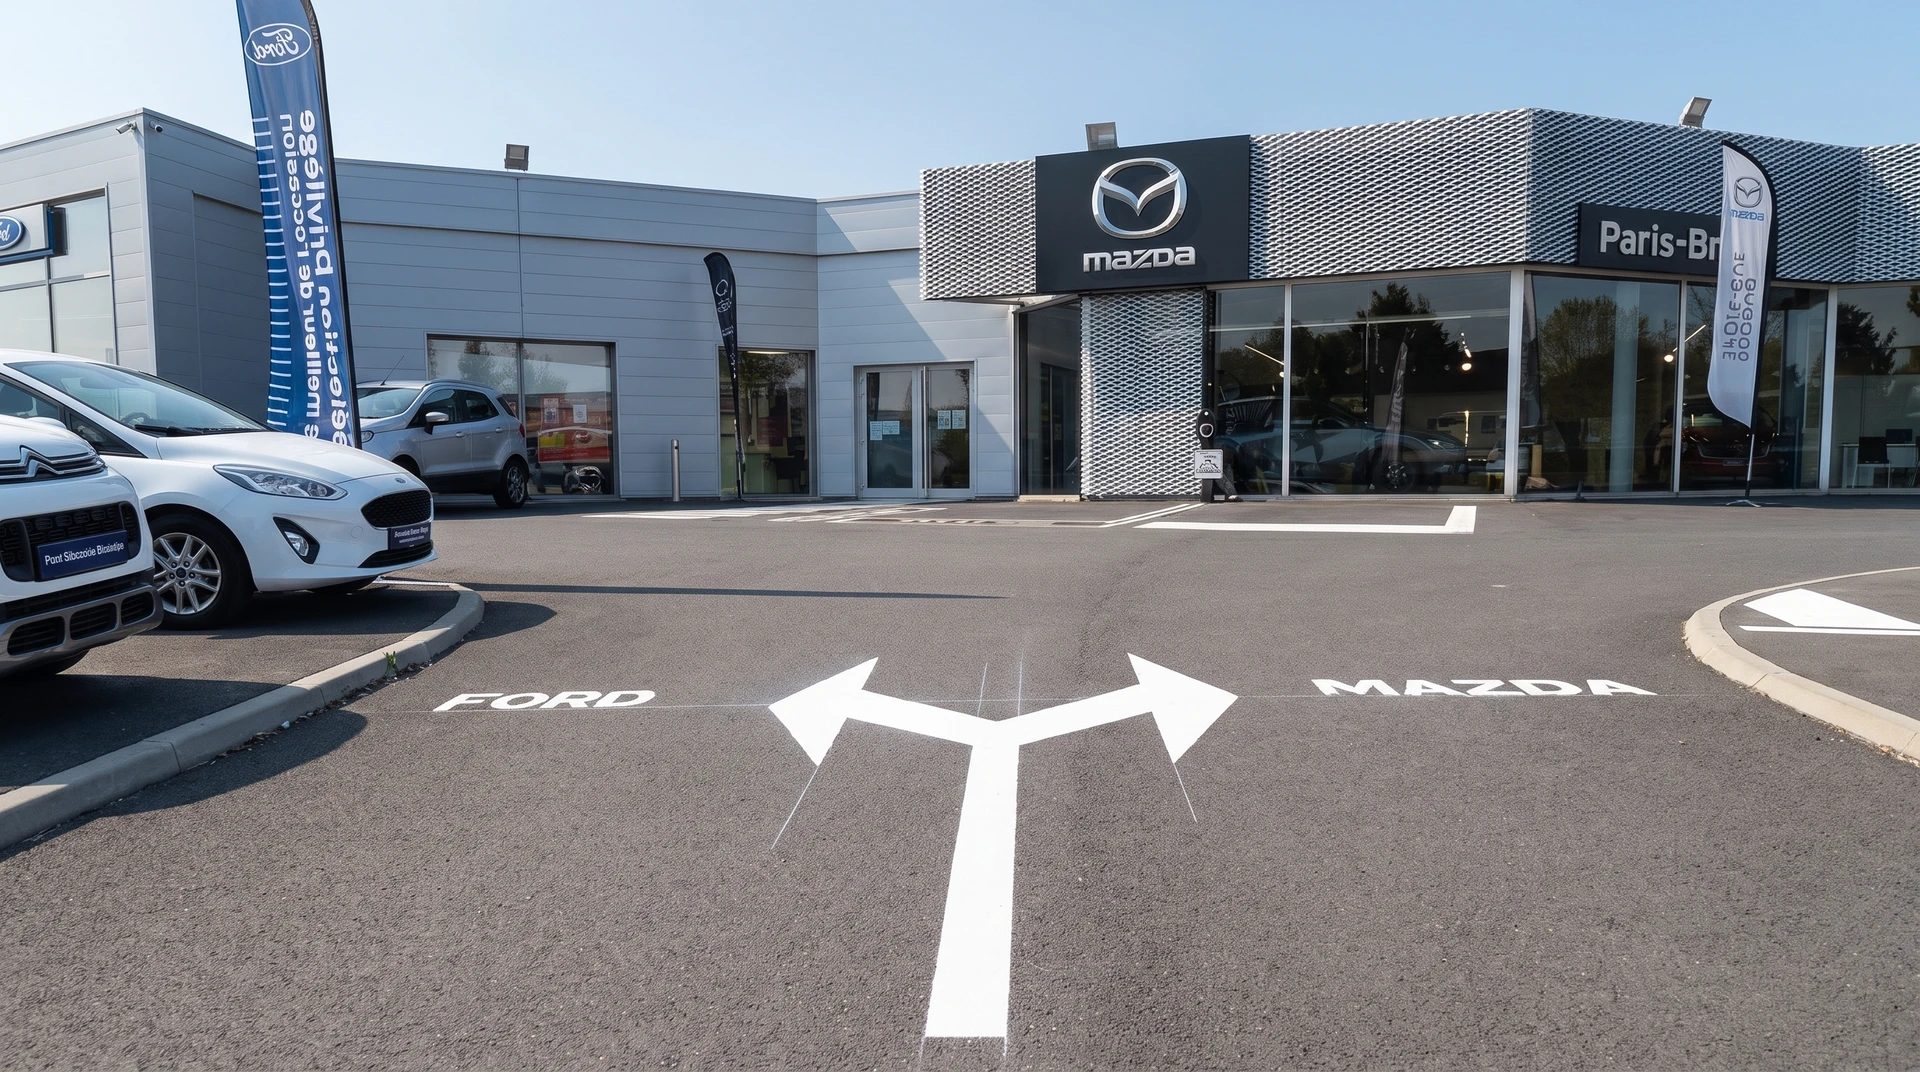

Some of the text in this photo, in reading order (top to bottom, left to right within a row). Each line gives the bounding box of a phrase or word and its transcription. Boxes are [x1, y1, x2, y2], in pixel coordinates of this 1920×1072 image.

[1083, 246, 1196, 272] mazda
[1311, 679, 1658, 697] MAZDA
[432, 690, 656, 712] FORD
